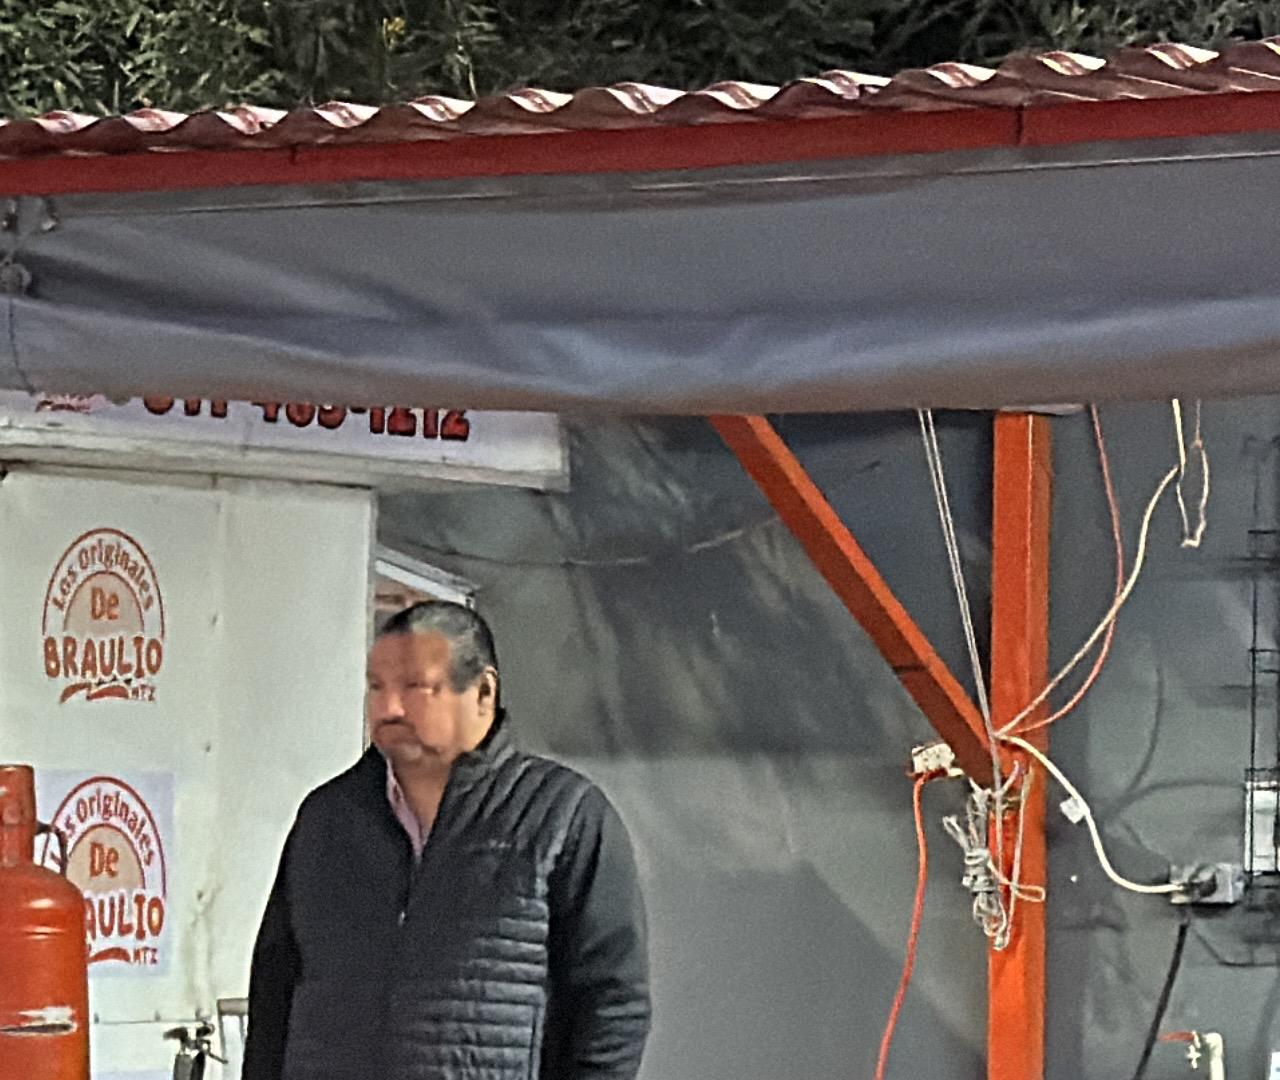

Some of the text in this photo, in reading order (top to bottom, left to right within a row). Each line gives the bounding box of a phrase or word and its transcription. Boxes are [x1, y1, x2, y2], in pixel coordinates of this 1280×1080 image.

[92, 587, 120, 620] De
[44, 635, 162, 678] BRAULIO
[90, 843, 119, 877] De
[85, 893, 164, 940] AULIO
